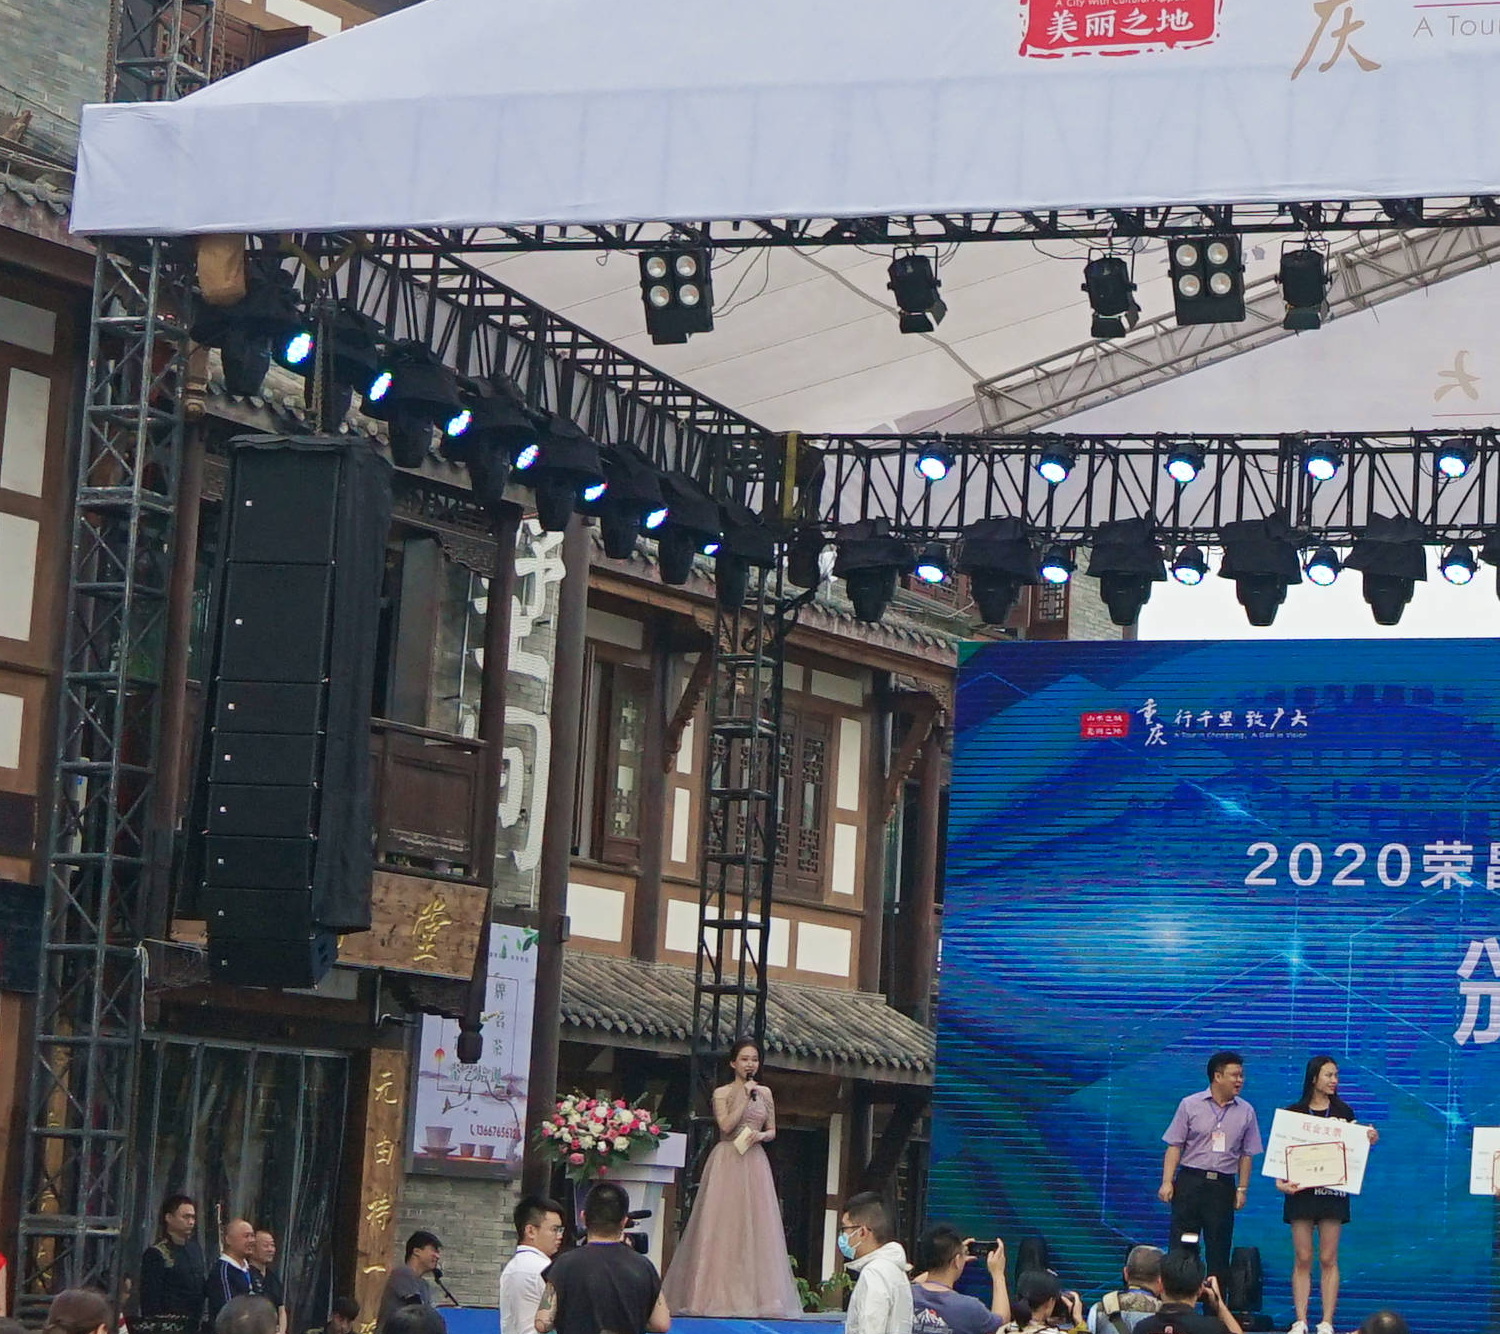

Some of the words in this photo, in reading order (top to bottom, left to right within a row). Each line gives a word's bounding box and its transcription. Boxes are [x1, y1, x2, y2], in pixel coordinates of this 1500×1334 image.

[1046, 7, 1194, 44] 美丽之地
[1413, 13, 1435, 38] A
[1136, 698, 1168, 746] 重庆
[1174, 708, 1234, 728] 行千里
[1245, 707, 1309, 730] 致广大
